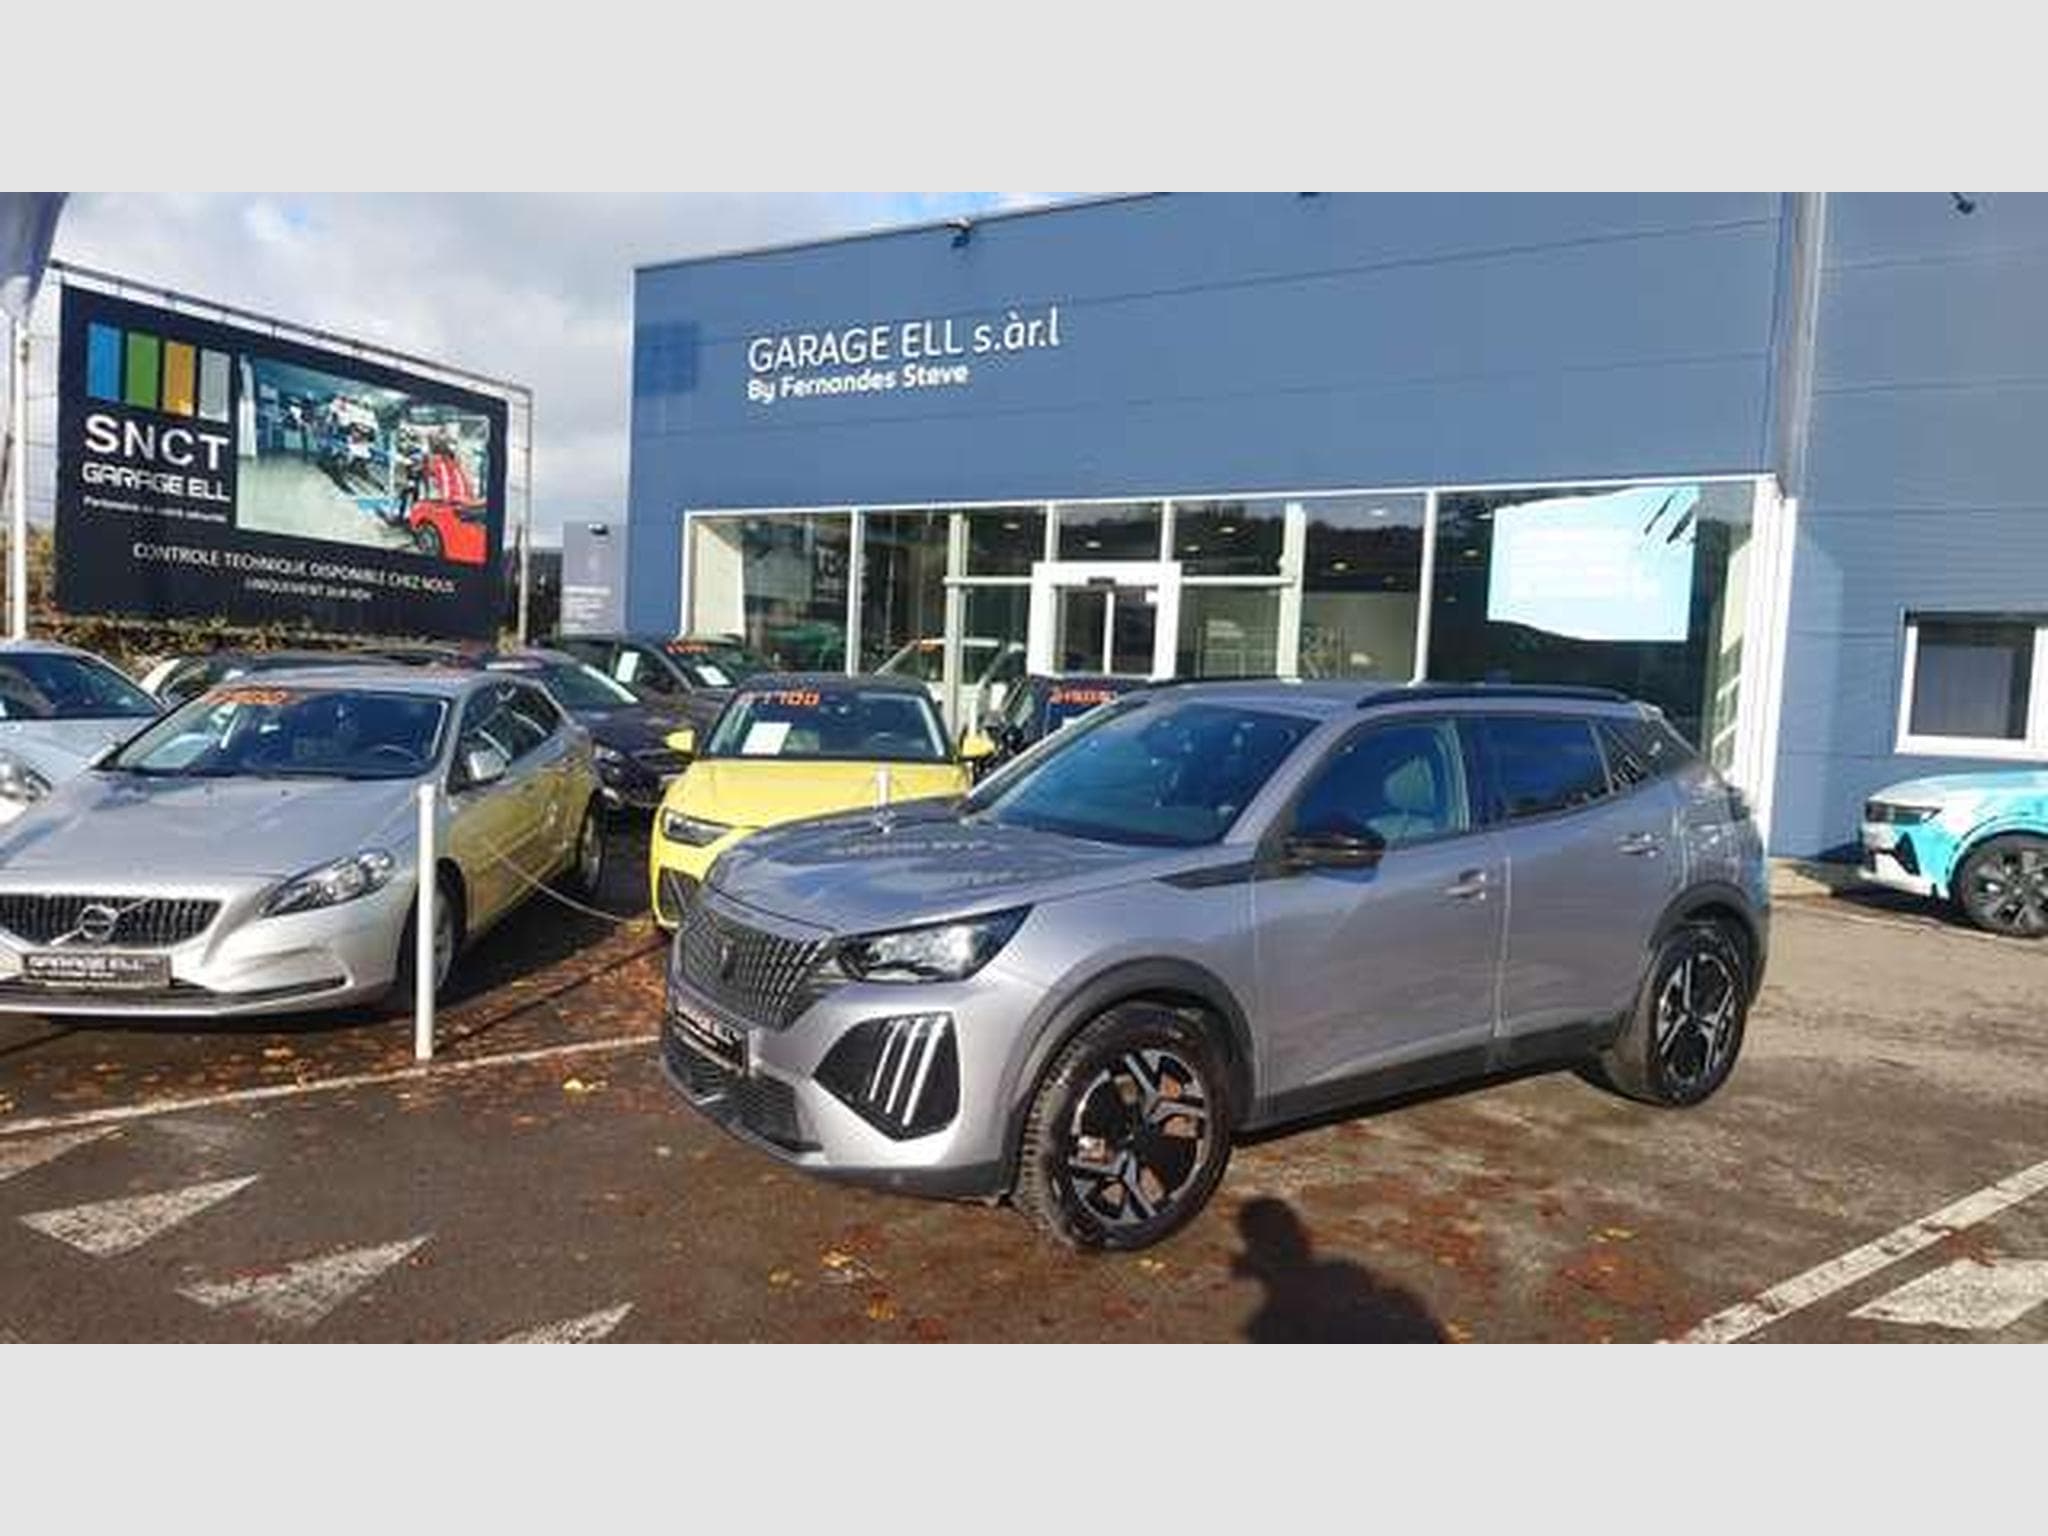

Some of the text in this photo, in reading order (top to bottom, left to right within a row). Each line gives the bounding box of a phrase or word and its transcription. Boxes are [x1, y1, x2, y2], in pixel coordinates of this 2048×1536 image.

[748, 325, 891, 373] GARAGE
[901, 319, 965, 358] ELL
[747, 362, 969, 404] By Fernandes Steve
[84, 413, 230, 471] SNCT
[81, 460, 232, 503] GARAGE ELL
